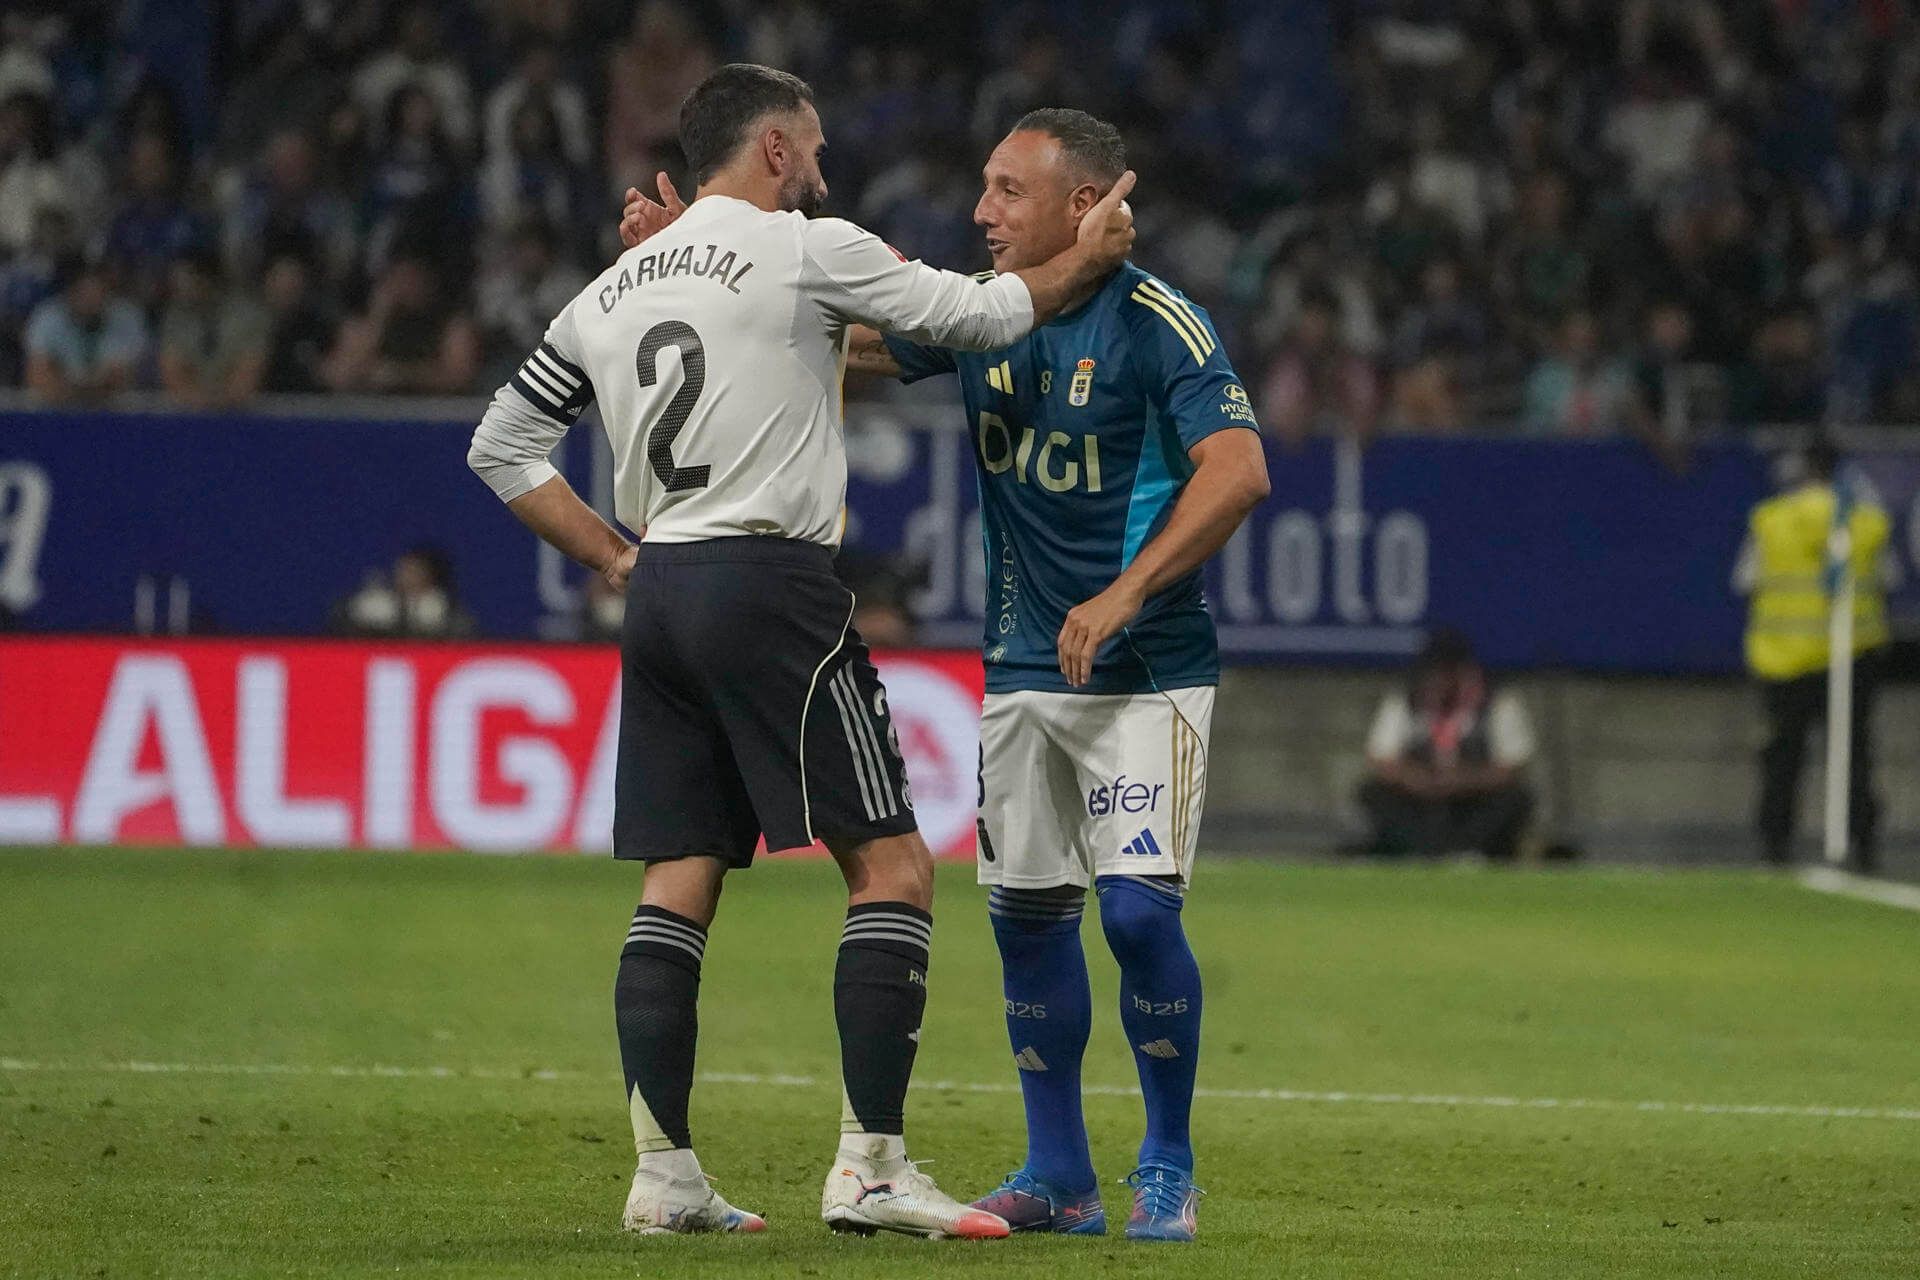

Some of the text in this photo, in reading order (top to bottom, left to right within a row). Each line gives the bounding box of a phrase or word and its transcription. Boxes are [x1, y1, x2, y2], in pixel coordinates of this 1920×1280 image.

[598, 244, 754, 314] CARVAJAL
[636, 319, 712, 494] 2
[1040, 371, 1052, 394] 8
[978, 411, 1101, 493] DIGI
[0, 652, 621, 853] ALIG
[1133, 995, 1187, 1016] 1926
